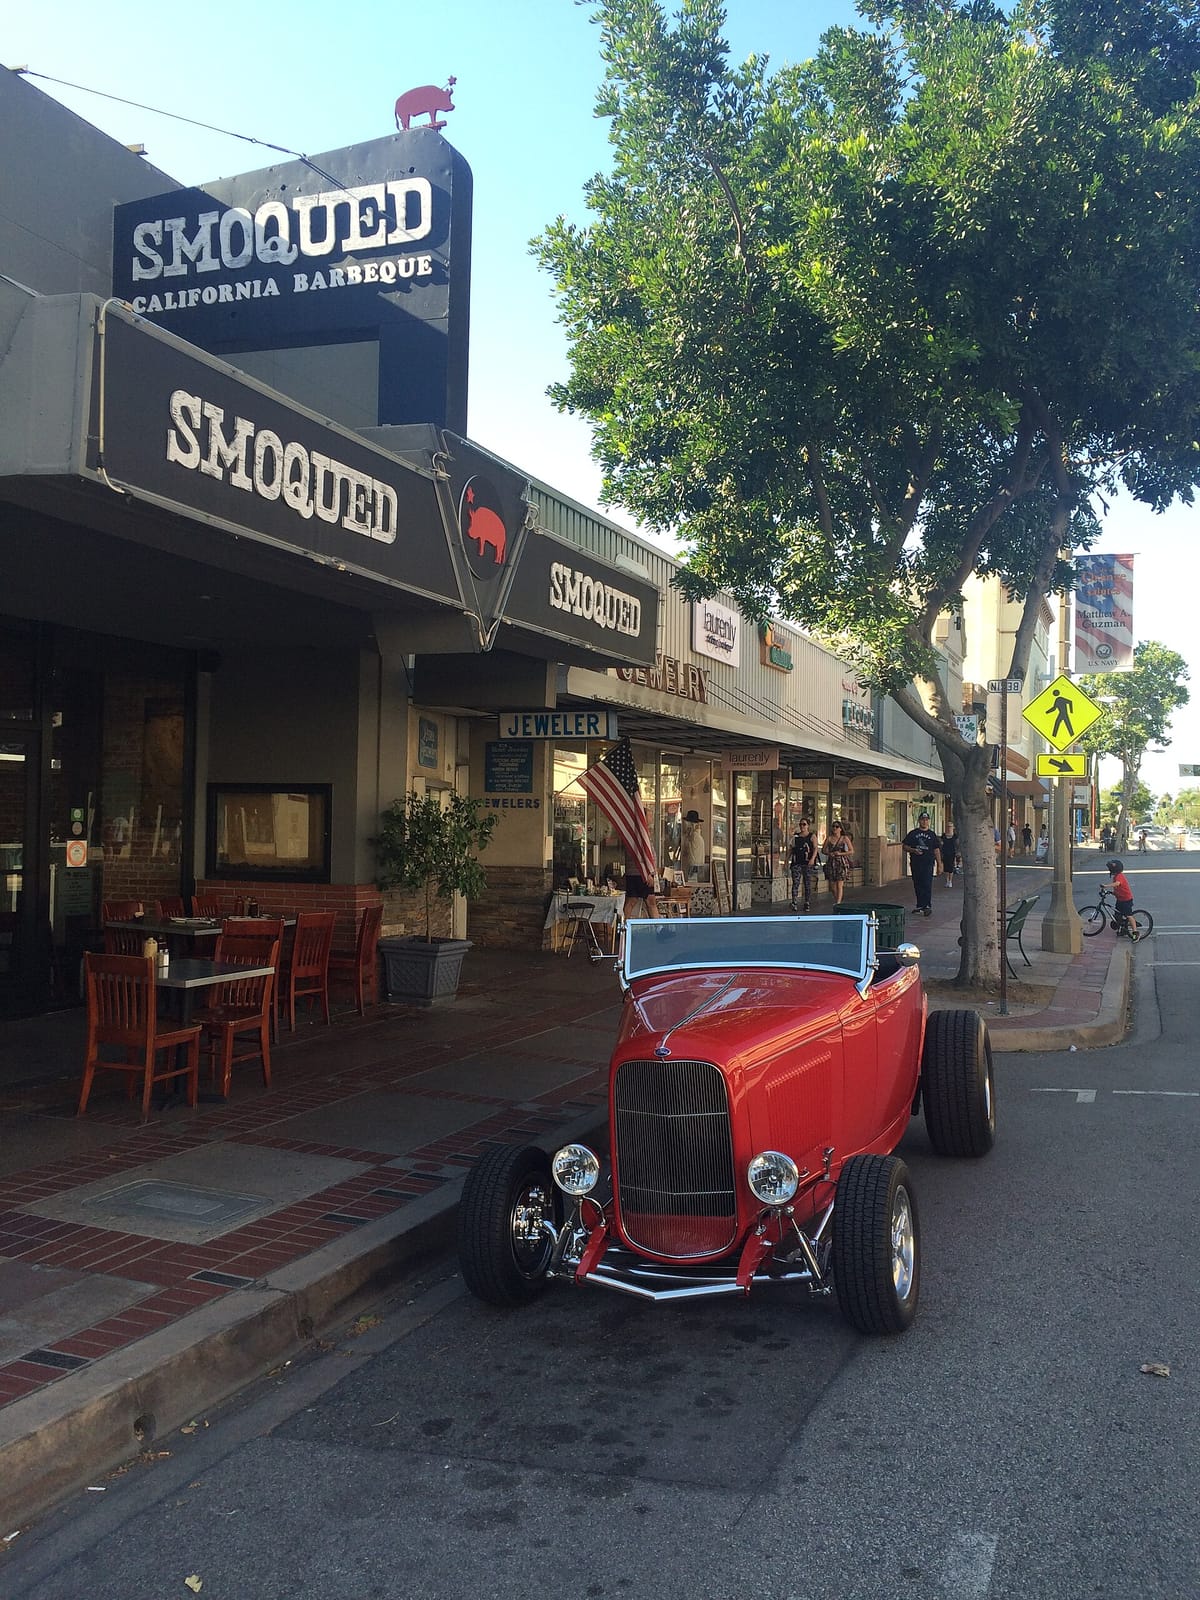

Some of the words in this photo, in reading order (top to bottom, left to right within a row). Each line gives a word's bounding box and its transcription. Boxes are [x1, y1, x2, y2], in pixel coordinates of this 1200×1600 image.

[131, 177, 432, 281] SMOQUED
[132, 278, 280, 314] CALIFORNIA
[293, 255, 432, 292] BARBEQUE
[166, 390, 398, 544] SMOQUED
[549, 561, 641, 638] SMOQUED
[1078, 610, 1115, 619] Matthew
[704, 603, 737, 649] laurenly
[1081, 620, 1126, 629] Guzman
[990, 681, 1019, 692] BEIN
[508, 713, 600, 736] JEWELER
[729, 751, 770, 764] laurenly
